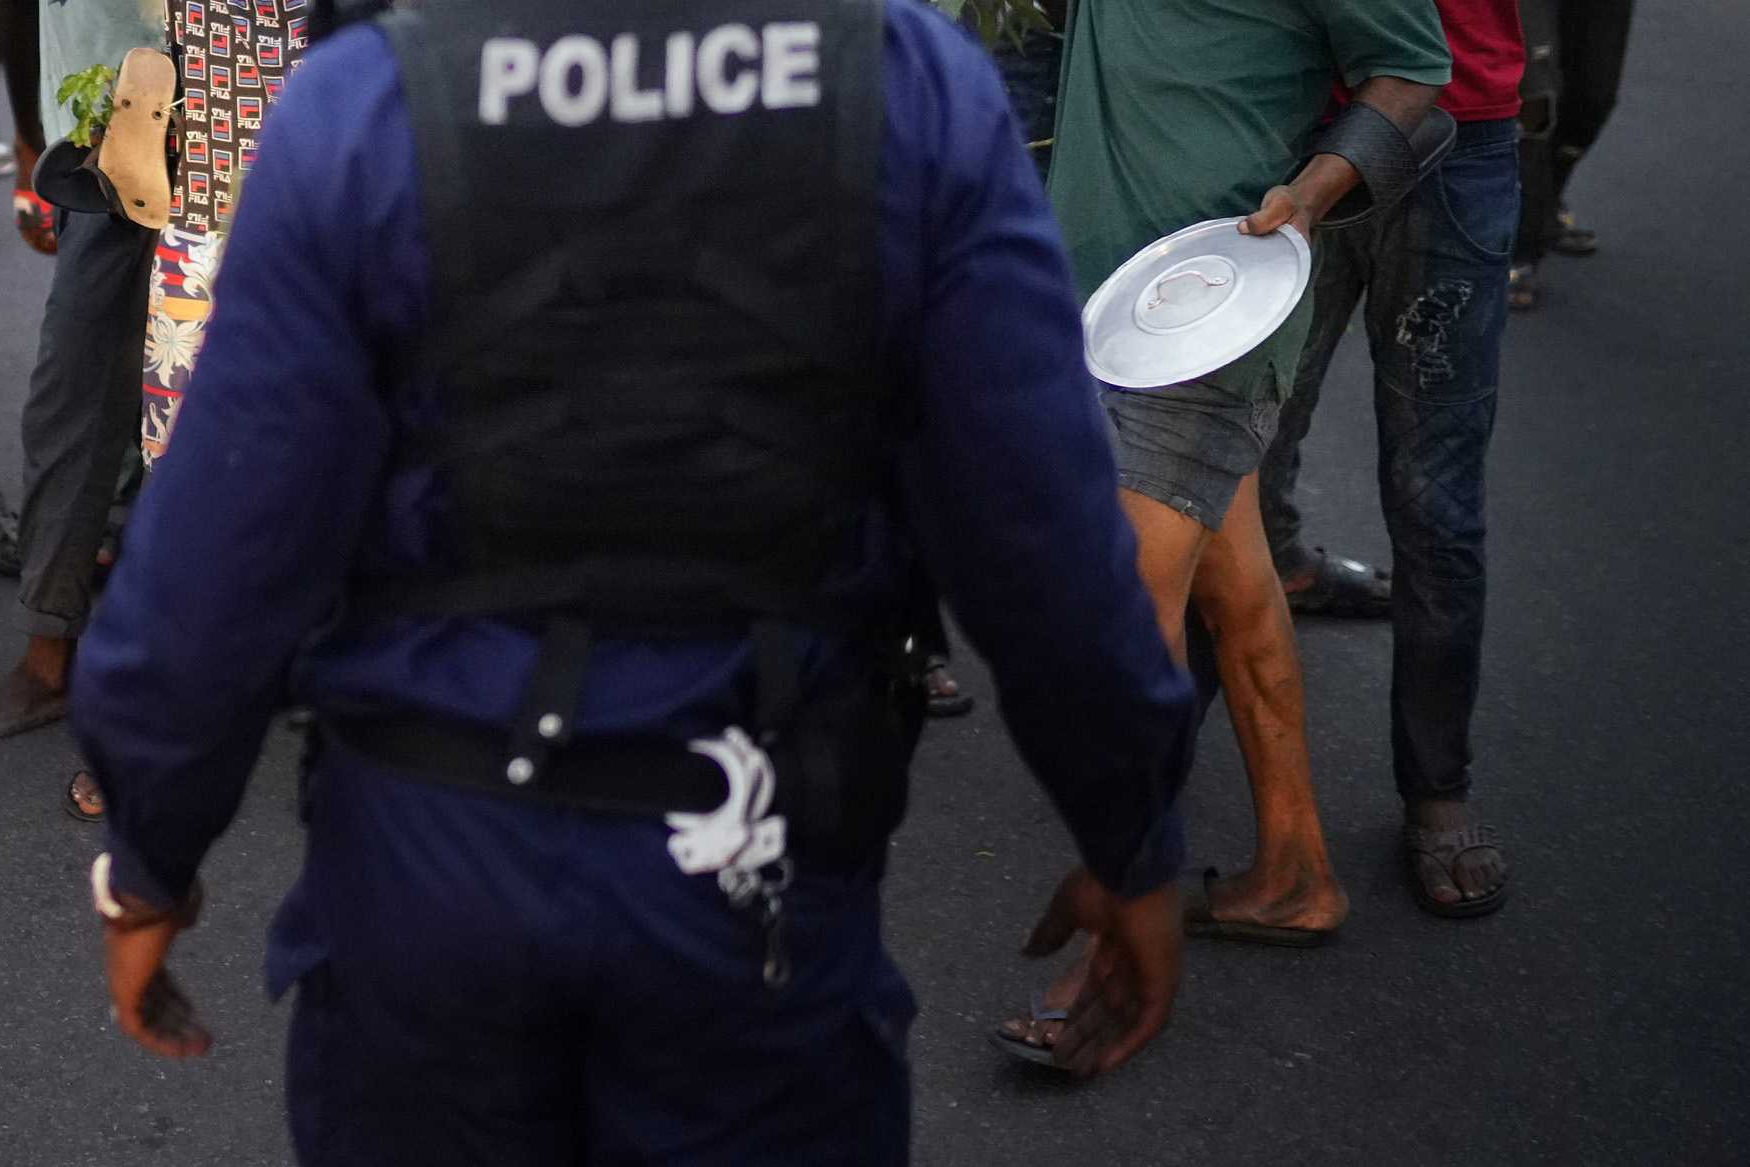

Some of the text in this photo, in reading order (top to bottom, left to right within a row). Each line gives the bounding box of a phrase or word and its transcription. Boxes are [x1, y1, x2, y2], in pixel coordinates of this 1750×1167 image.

[210, 3, 228, 14] FILA
[211, 22, 230, 34] FILA
[256, 18, 279, 28] FILA
[186, 26, 204, 37] FILA
[258, 35, 282, 46] FILA
[186, 45, 205, 56] FILA
[478, 21, 820, 126] POLICE
[211, 89, 230, 100] FILA
[186, 112, 206, 122] FILA
[211, 108, 231, 119] FILA
[238, 120, 261, 129] FILA
[186, 131, 207, 141] FILA
[213, 174, 231, 183] FILA
[188, 194, 209, 205] FILA
[187, 212, 209, 222] FILA
